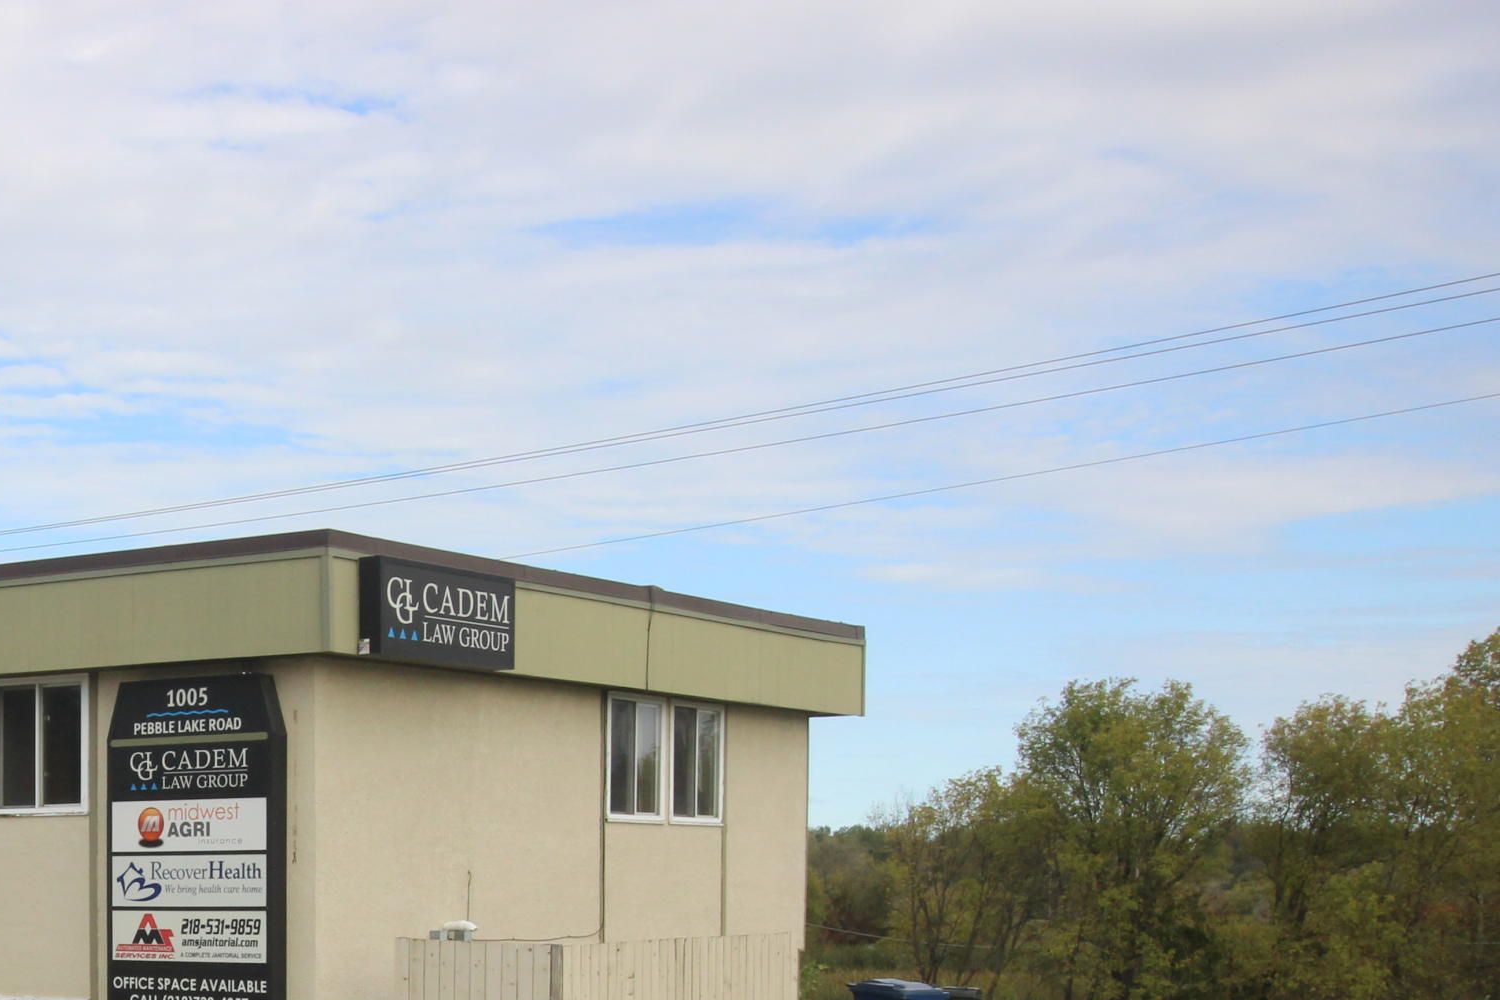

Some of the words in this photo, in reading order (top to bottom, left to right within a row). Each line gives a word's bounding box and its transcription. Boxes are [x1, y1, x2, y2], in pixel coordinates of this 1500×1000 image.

[422, 582, 510, 624] CADEM
[422, 621, 456, 645] LAW
[458, 626, 510, 652] GROUP
[166, 687, 208, 707] 1005
[133, 720, 175, 735] PEBBLE
[178, 718, 206, 733] LAKE
[208, 717, 242, 731] ROAD
[161, 748, 248, 771] CADEM
[161, 775, 193, 790] LAW
[196, 773, 248, 789] GROUP
[167, 802, 240, 822] midwest
[167, 822, 211, 837] AGRI
[198, 836, 243, 845] insurance
[150, 861, 262, 880] RecoverHealth
[164, 884, 176, 894] We
[177, 884, 197, 897] bring
[199, 884, 222, 894] health
[223, 886, 240, 894] care
[241, 885, 263, 894] home
[181, 918, 261, 936] 218-531-9859
[181, 937, 259, 949] amsjanitorial.com
[113, 976, 155, 990] OFFICE
[157, 978, 197, 992] SPACE
[200, 979, 268, 994] AVAILABLE
